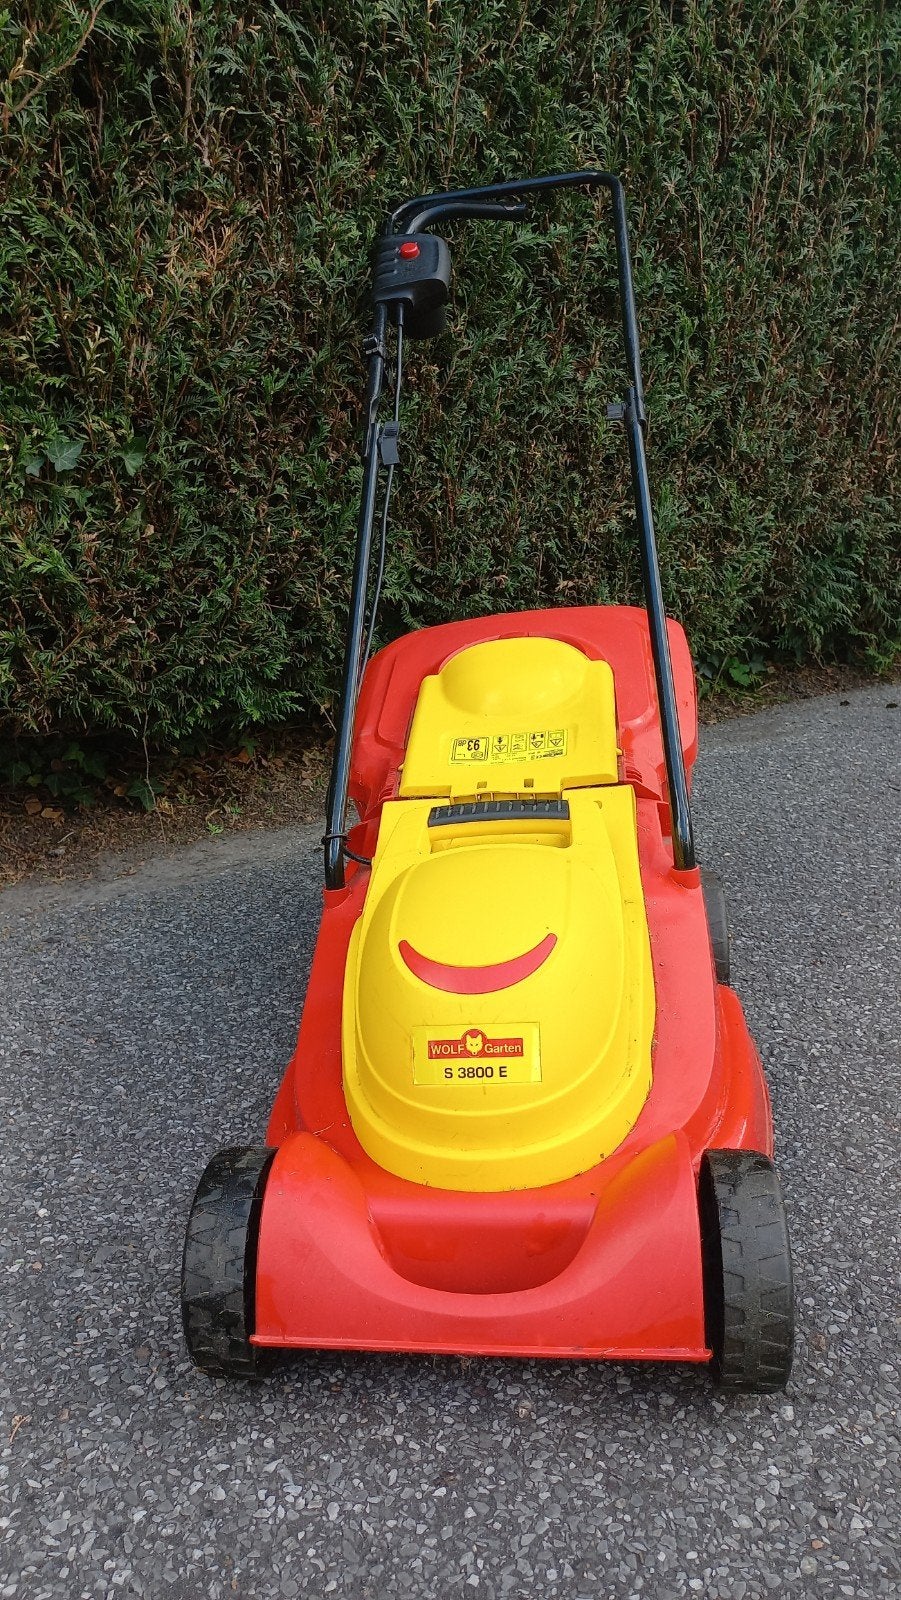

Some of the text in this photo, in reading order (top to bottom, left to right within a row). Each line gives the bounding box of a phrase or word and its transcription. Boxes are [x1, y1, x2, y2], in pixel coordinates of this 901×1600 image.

[467, 739, 480, 751] 93
[430, 1043, 522, 1055] WOLF Garten
[444, 1066, 508, 1079] S 3800 E
